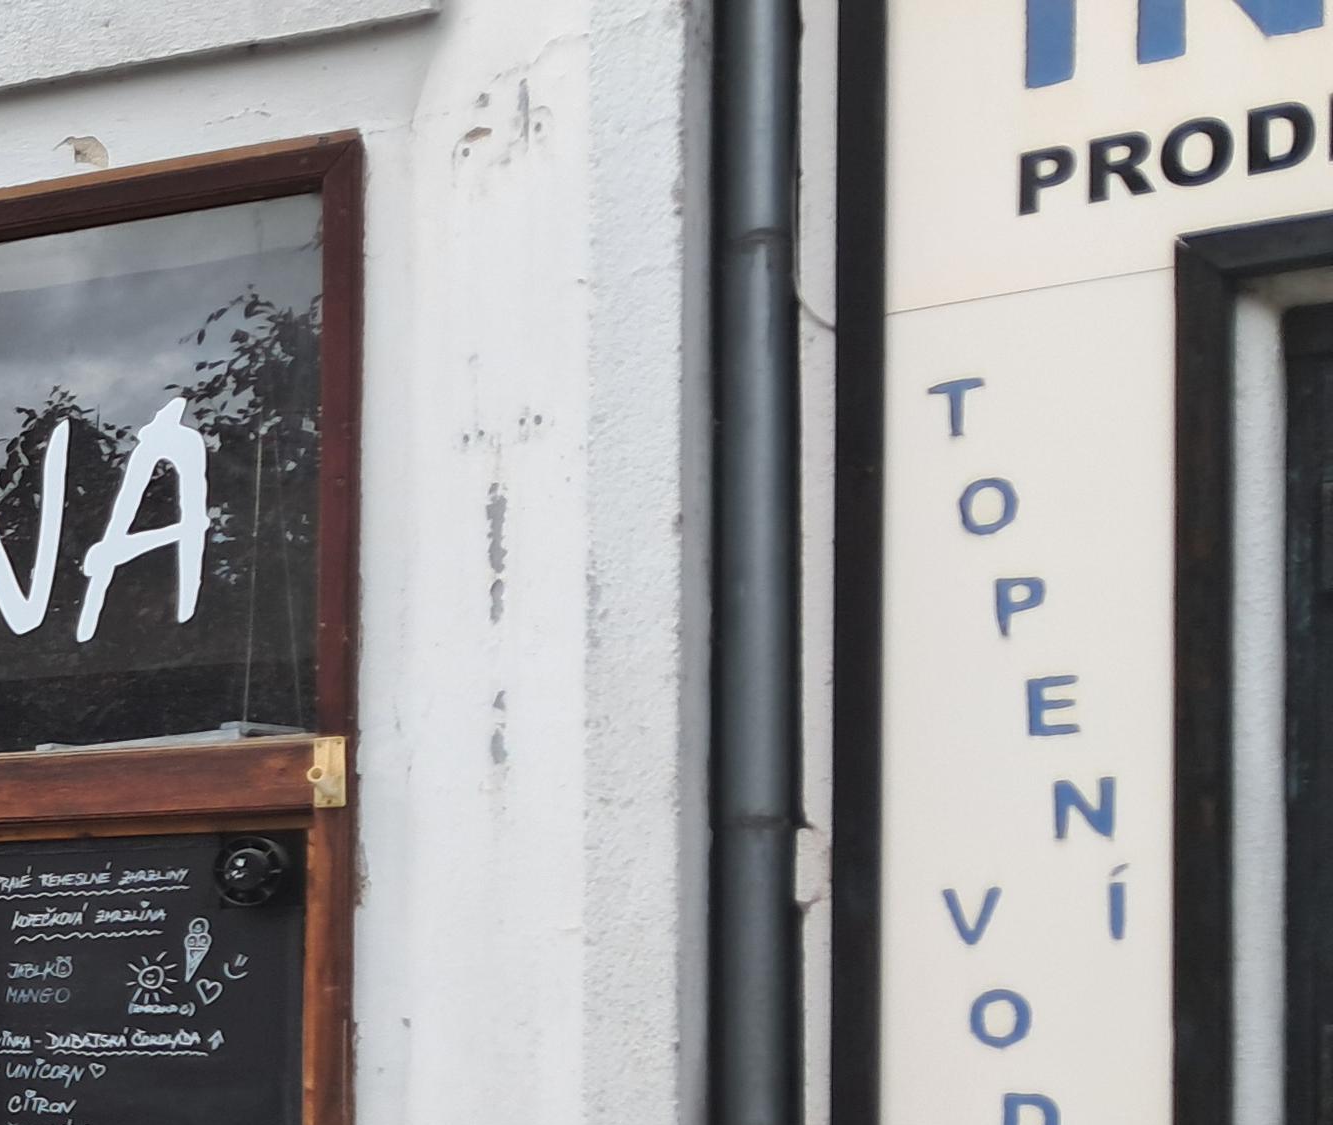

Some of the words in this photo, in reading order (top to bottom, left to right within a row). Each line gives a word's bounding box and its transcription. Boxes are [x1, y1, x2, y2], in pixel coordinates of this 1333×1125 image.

[1018, 92, 1333, 217] PROD
[927, 377, 1129, 941] TOPENÍ
[6, 986, 71, 1003] MANGO
[5, 1057, 85, 1087] UNICORN
[7, 1088, 77, 1114] CITRON
